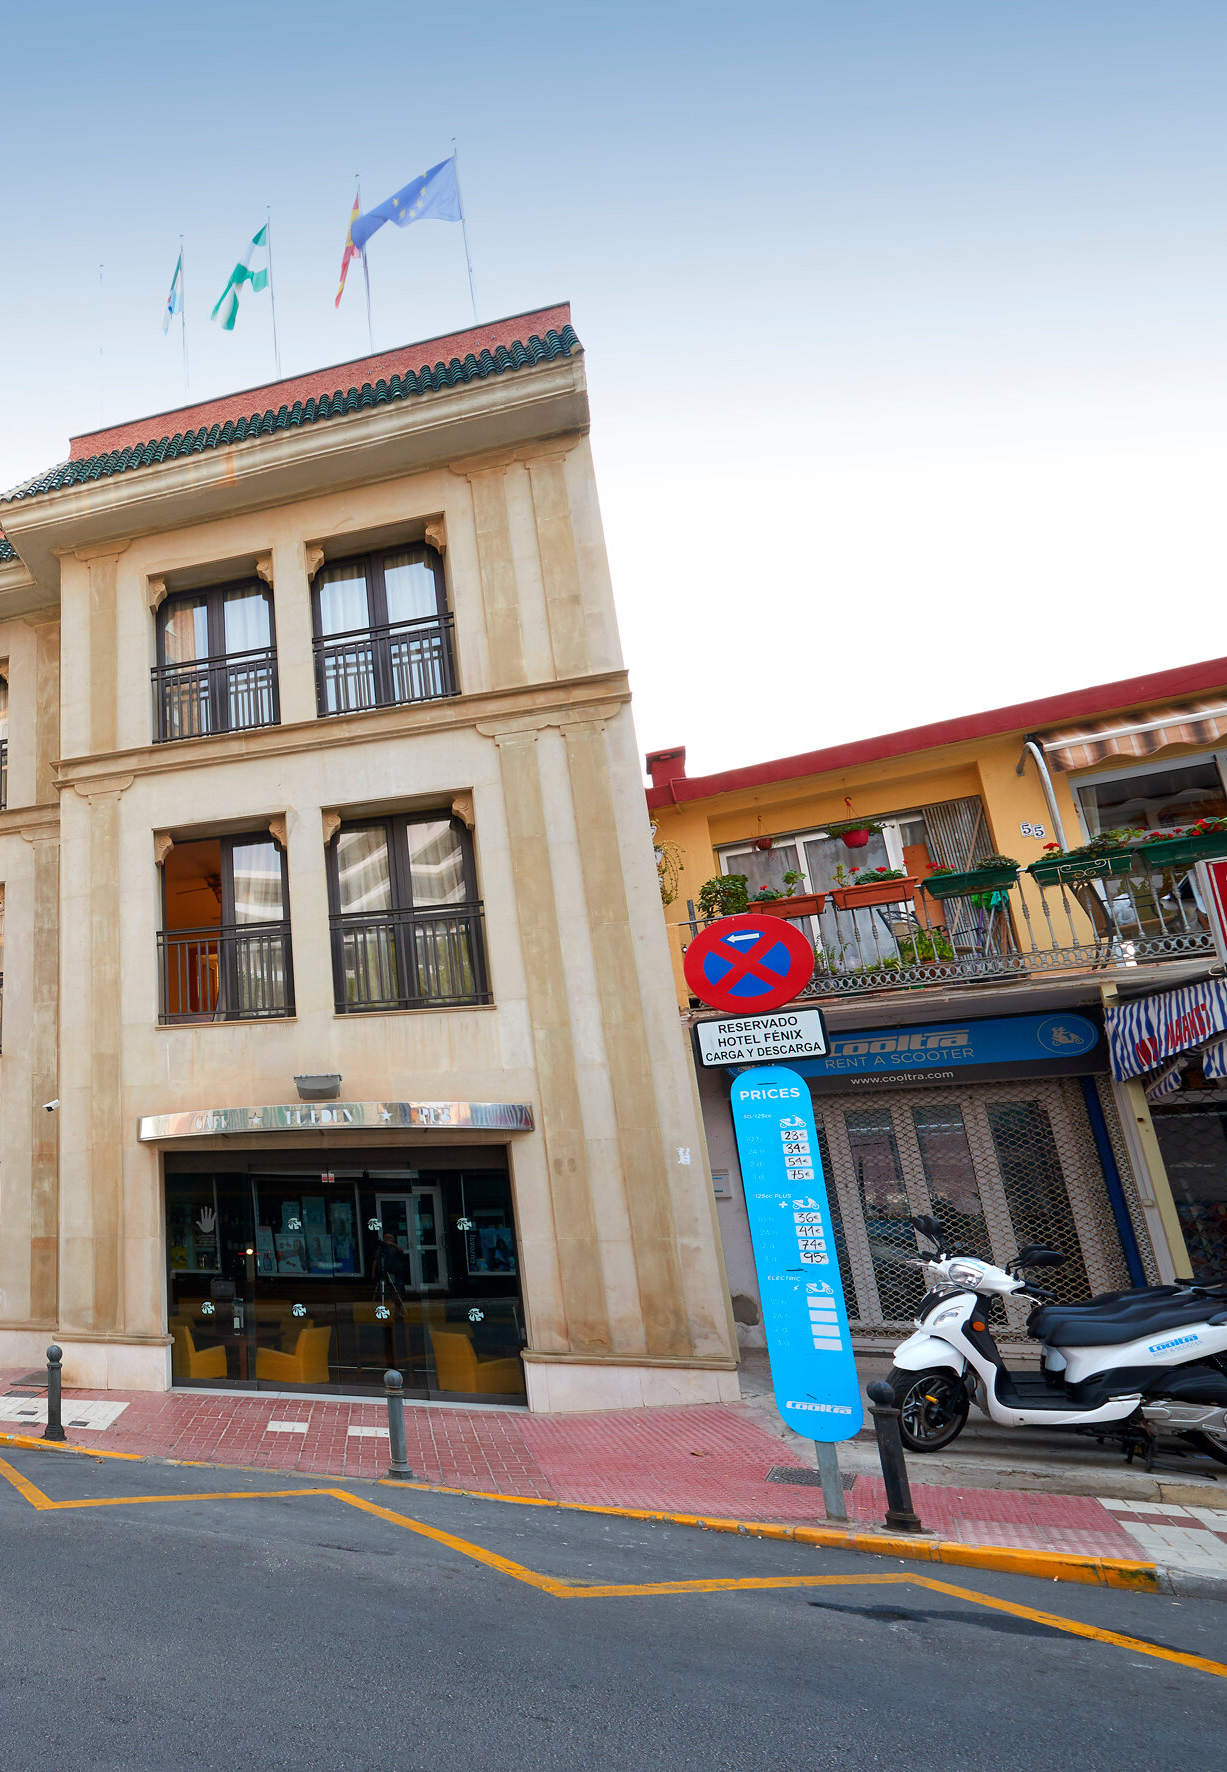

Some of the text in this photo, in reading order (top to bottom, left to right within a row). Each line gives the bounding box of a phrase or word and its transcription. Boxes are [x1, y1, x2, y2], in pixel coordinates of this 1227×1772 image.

[718, 1016, 798, 1034] RESERVADO
[718, 1029, 803, 1048] HOTEL FÉNIX
[705, 1042, 822, 1061] CARGA Y DESCARGA
[825, 1047, 975, 1070] RENT A SCOOTER
[850, 1071, 955, 1085] www.cooltra.com
[739, 1088, 801, 1101] PRICES
[418, 1107, 451, 1123] PUB
